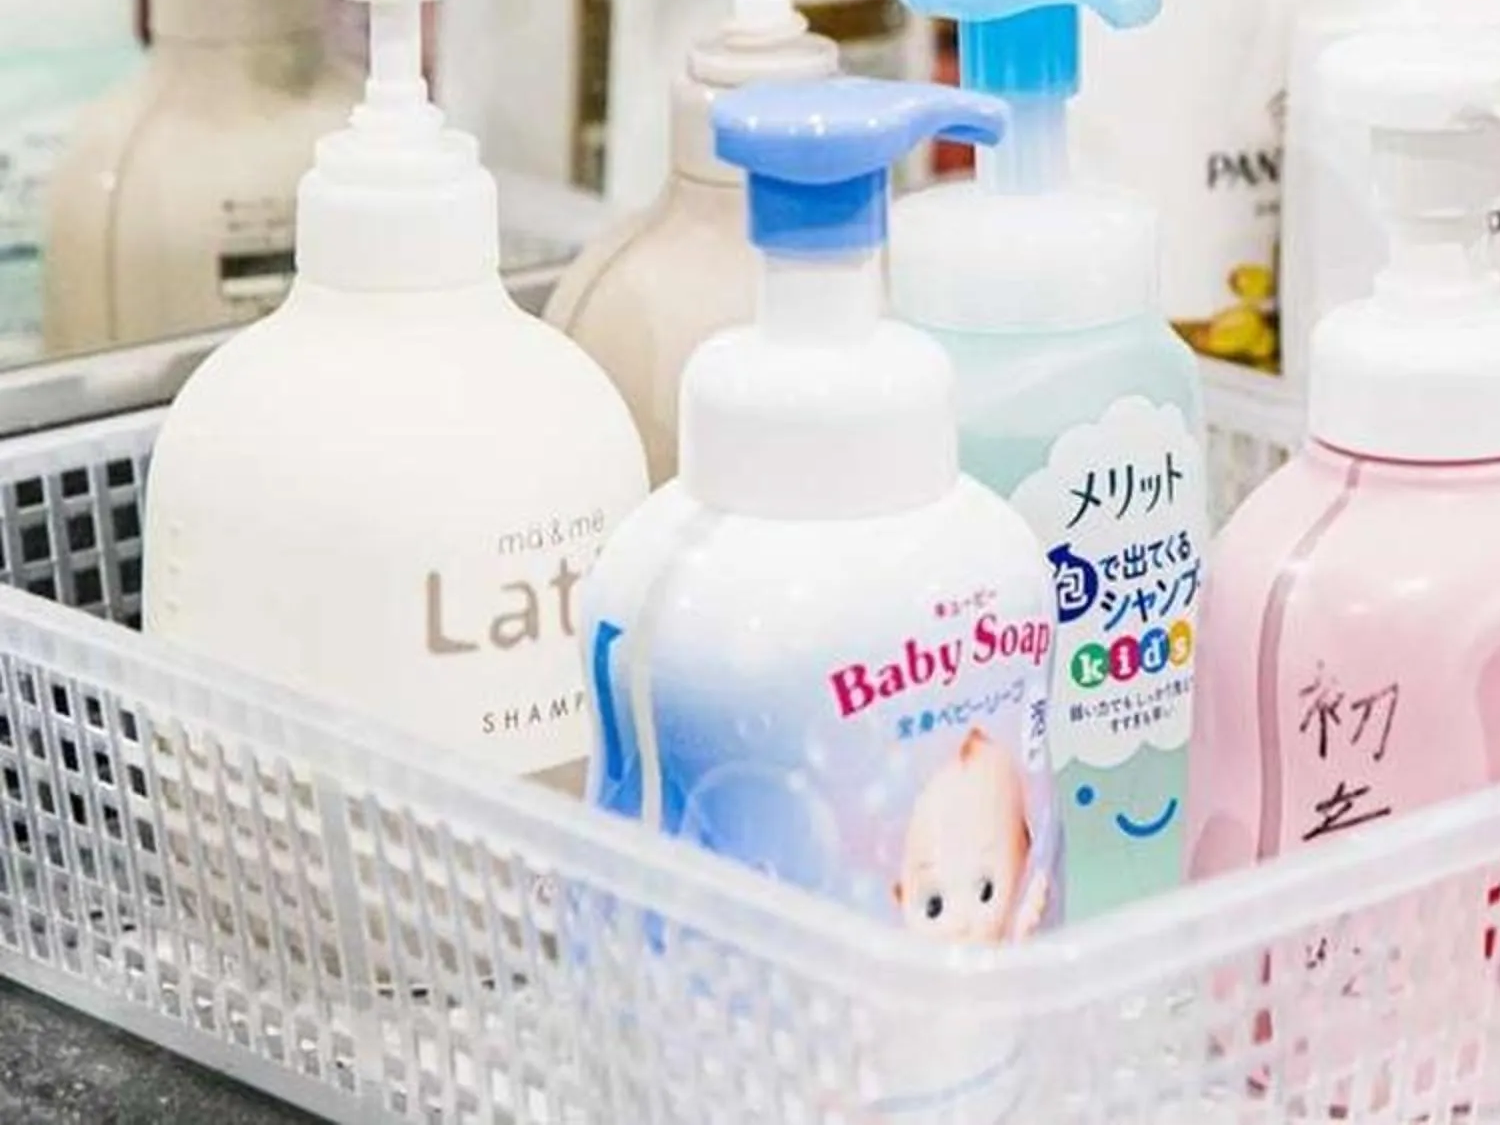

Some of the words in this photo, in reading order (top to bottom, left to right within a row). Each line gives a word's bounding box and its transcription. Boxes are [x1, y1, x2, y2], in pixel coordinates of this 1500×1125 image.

[1065, 451, 1184, 530] メリット
[426, 553, 594, 656] Lat
[1100, 557, 1201, 631] シャンプ
[831, 639, 962, 717] Baby
[973, 613, 1051, 666] Soap
[1074, 629, 1190, 686] kids
